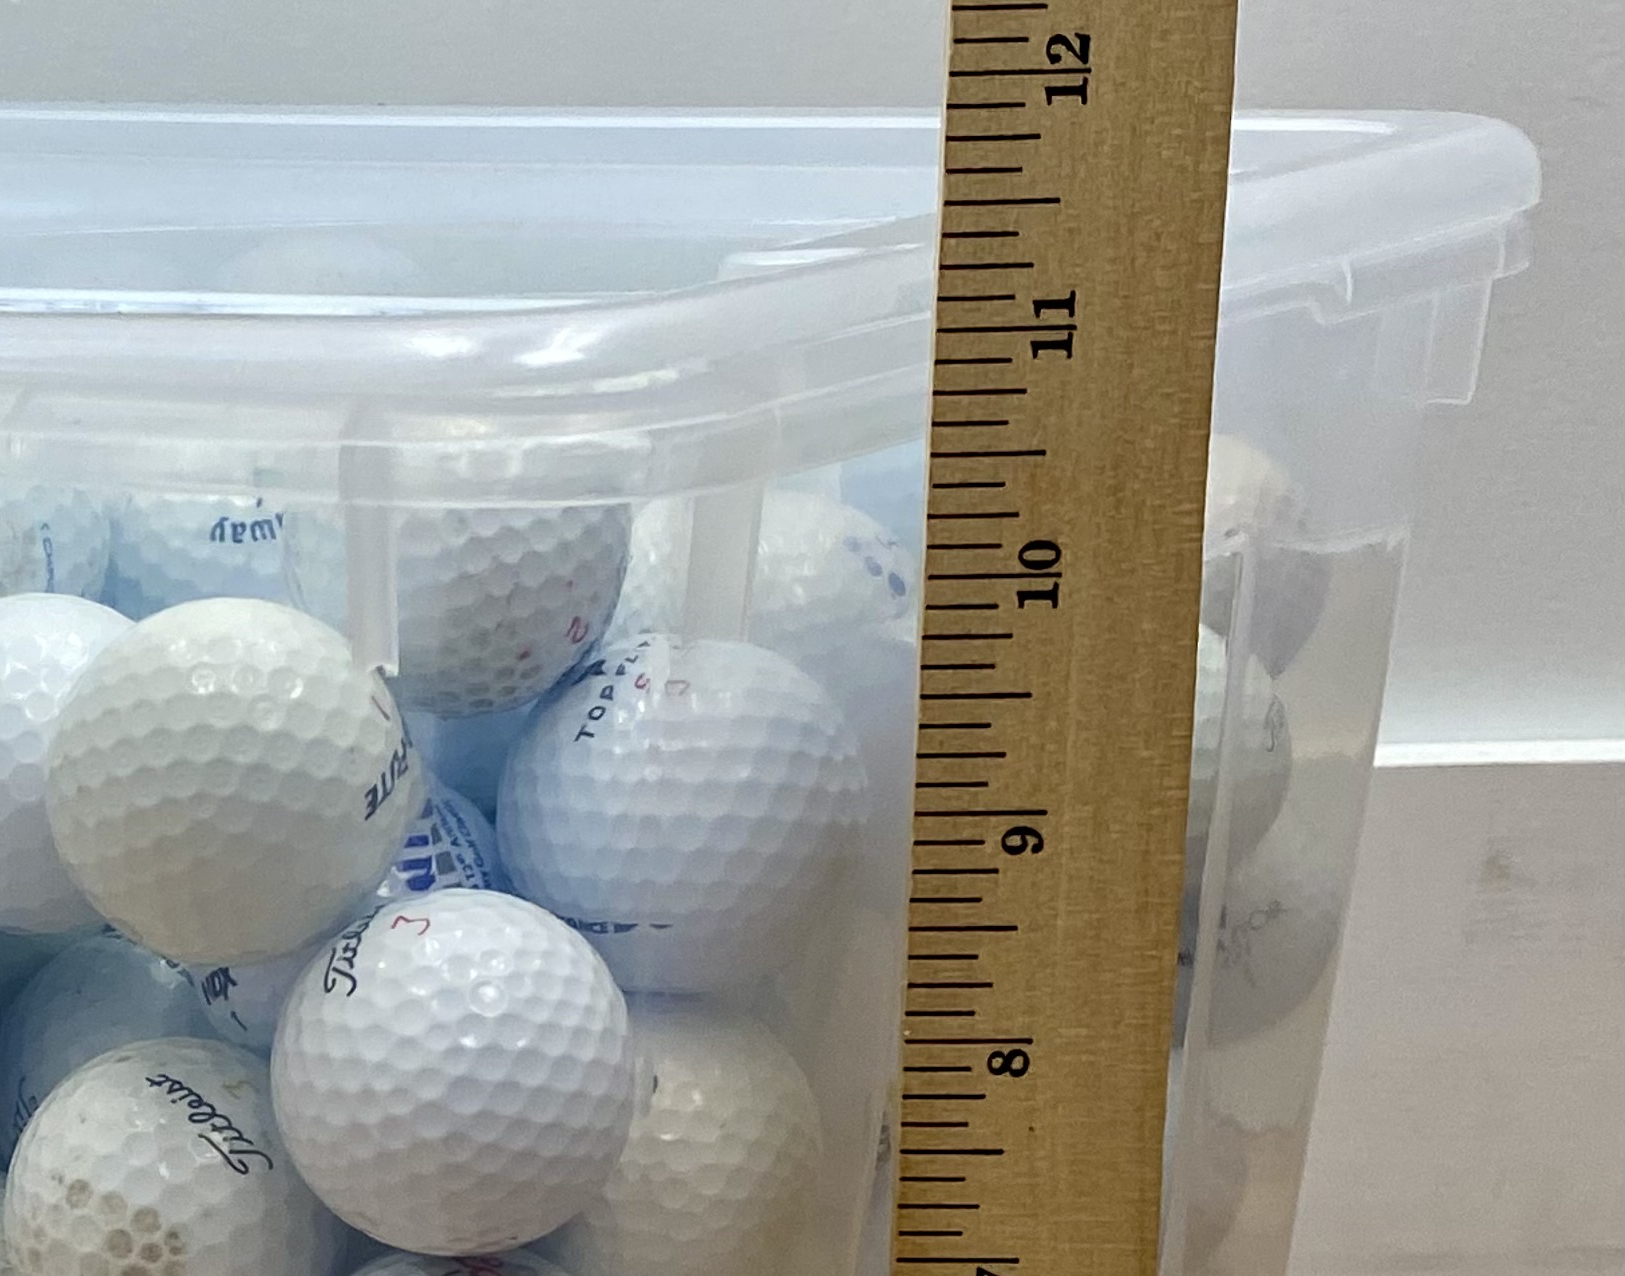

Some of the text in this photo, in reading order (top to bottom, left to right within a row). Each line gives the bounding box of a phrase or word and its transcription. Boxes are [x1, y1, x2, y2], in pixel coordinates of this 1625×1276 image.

[1045, 31, 1093, 106] 12
[1030, 289, 1078, 360] 11
[1017, 540, 1062, 610] 10
[1001, 826, 1045, 856] 9
[987, 1048, 1031, 1079] 8
[145, 1073, 274, 1175] Titleist
